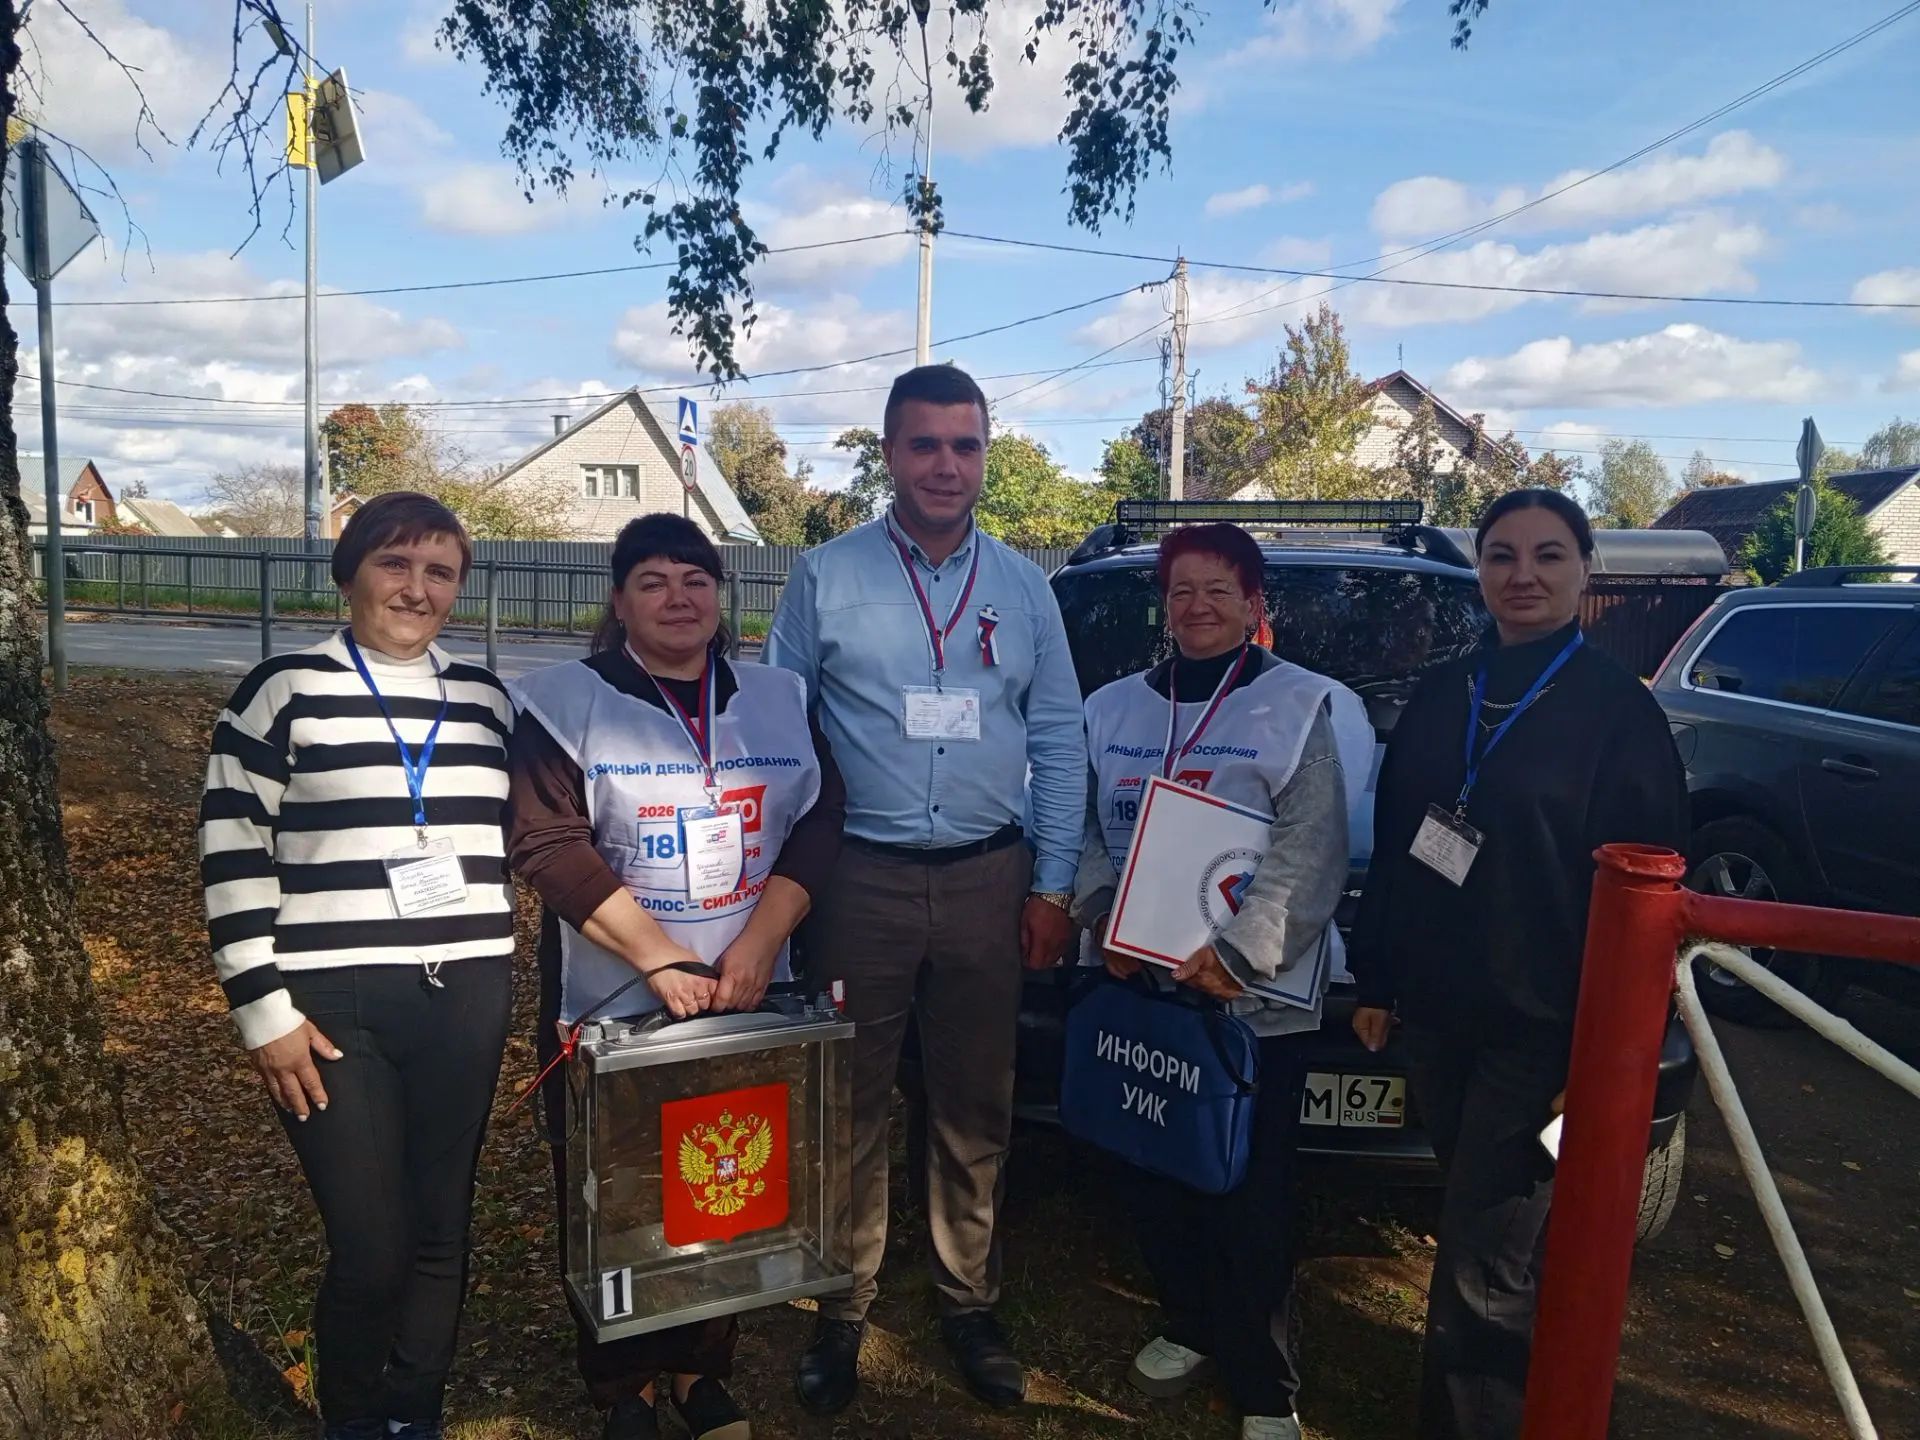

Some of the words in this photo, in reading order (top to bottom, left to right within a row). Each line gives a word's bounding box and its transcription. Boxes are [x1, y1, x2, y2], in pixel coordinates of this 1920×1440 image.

[684, 458, 694, 478] 20
[1104, 743, 1143, 757] ИНЫЙ
[1142, 748, 1166, 760] ДЕН
[655, 763, 695, 777] ДЕНЬ
[696, 756, 802, 774] ГЛОСОВАНИЯ
[638, 805, 675, 818] 2026
[1113, 800, 1138, 821] 18
[642, 834, 675, 859] 18
[1200, 850, 1236, 894] Смоленской
[702, 893, 743, 911] СИЛА
[1200, 896, 1218, 931] области
[1096, 1030, 1200, 1095] ИНФОРМ
[1121, 1082, 1168, 1128] УИК
[1346, 1078, 1391, 1111] 67
[1344, 1109, 1376, 1123] RUS
[605, 1268, 631, 1318] 1
